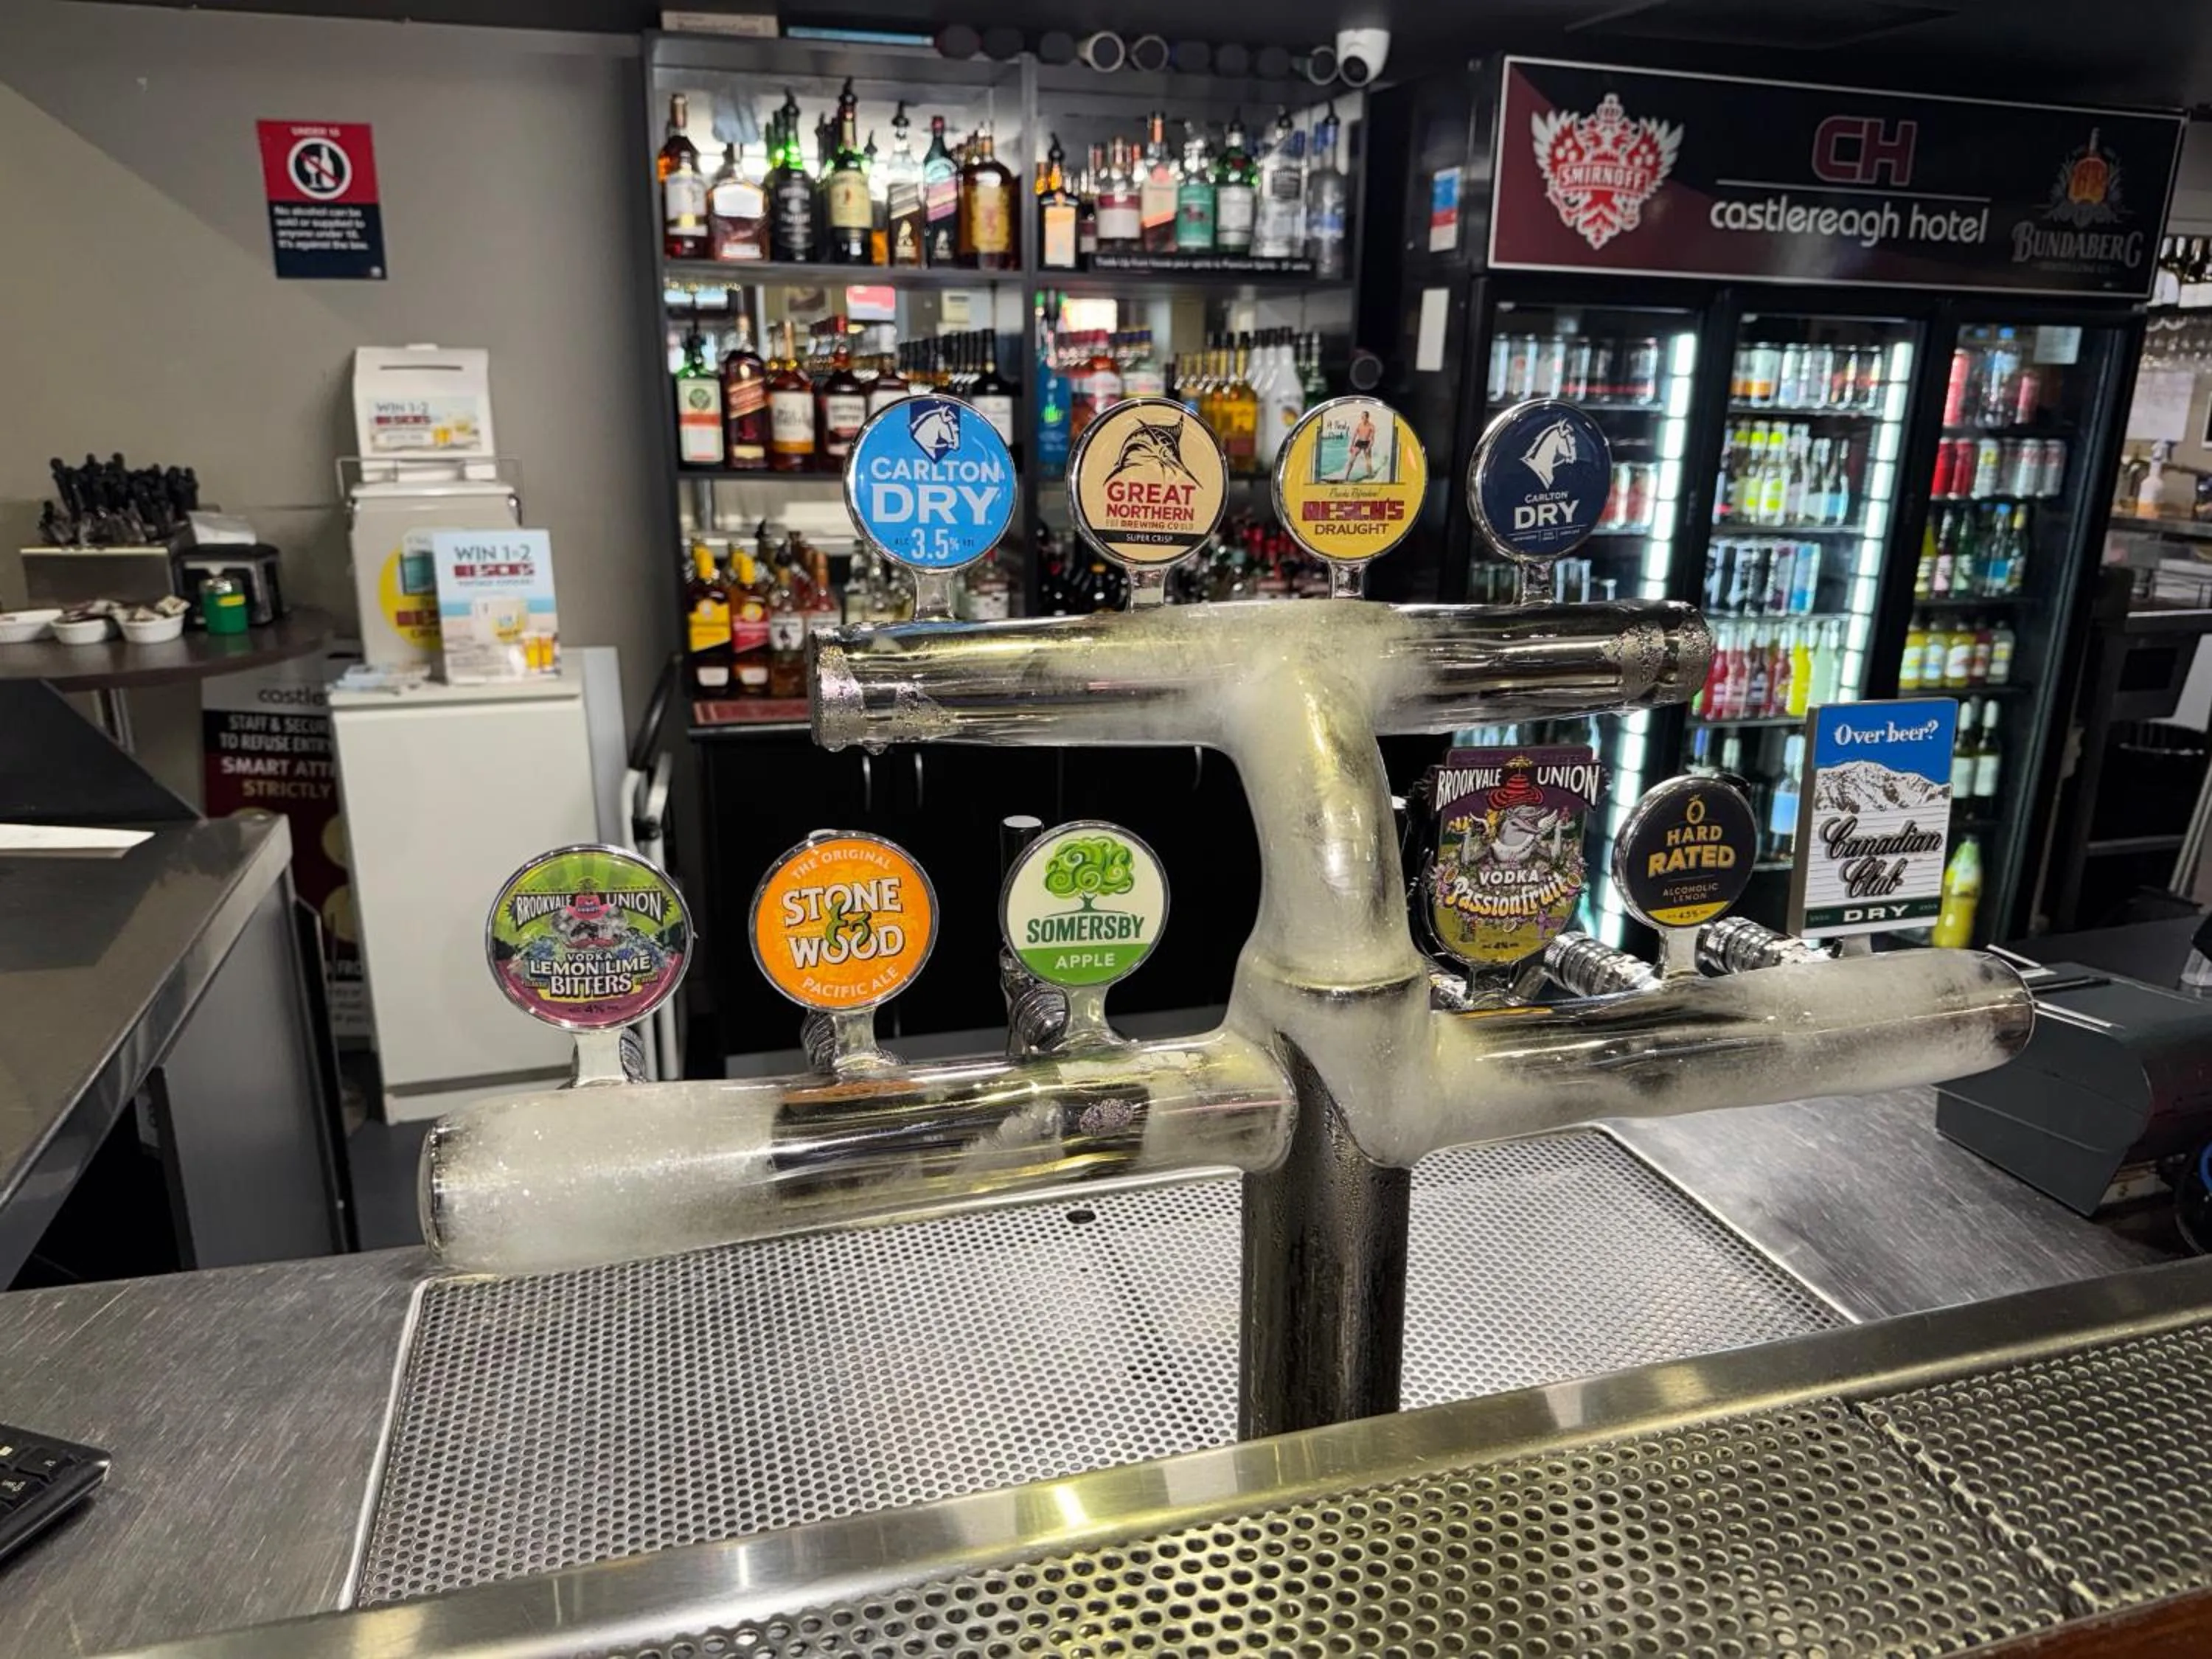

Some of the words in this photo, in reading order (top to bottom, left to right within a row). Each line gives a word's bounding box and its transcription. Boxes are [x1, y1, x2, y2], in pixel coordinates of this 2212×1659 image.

[1812, 115, 1917, 187] CH
[1559, 165, 1644, 192] SMIRNOFF
[1710, 194, 1900, 248] castlereagh
[1908, 204, 1989, 245] hotel
[871, 456, 1000, 483] CARLTON
[870, 483, 1000, 526] DRY
[1107, 481, 1196, 506] GREAT
[1524, 491, 1569, 504] CARLTON
[1106, 504, 1194, 521] NORTHERN
[1514, 500, 1581, 529] DRY
[1120, 520, 1165, 529] BREWING
[1315, 523, 1389, 535] DRAUGHT
[1126, 533, 1150, 542] SUPER
[1151, 535, 1174, 543] CRISP
[454, 545, 496, 561] WIN
[259, 686, 330, 706] castle
[229, 715, 267, 731] STAFF
[269, 717, 282, 732] &
[1834, 724, 1885, 745] Over
[1886, 720, 1939, 742] beer?
[219, 733, 239, 749] TO
[240, 734, 290, 751] REFUSE
[222, 757, 291, 776] SMART
[294, 760, 332, 779] ATT
[243, 780, 331, 799] STRICTLY
[1436, 768, 1502, 811] BROOKVALE
[1537, 765, 1600, 806] UNION
[1667, 825, 1723, 846] HARD
[1819, 815, 1944, 859] Canadian
[793, 858, 819, 879] THE
[821, 849, 891, 870] ORIGINAL
[1648, 844, 1736, 879] RATED
[1479, 869, 1540, 885] VODKA
[1840, 856, 1908, 898] Club
[782, 877, 902, 926] STONE
[1446, 872, 1568, 916] Passionfruit
[1663, 883, 1719, 897] ALCOHOLIC
[1673, 892, 1707, 904] LEMON
[517, 894, 572, 925] BROOKVALE
[606, 892, 662, 922] UNION
[1844, 904, 1910, 922] DRY
[826, 901, 872, 950] &
[1026, 914, 1144, 944] SOMERSBY
[566, 952, 613, 961] VODKA
[789, 925, 905, 968] WOOD
[530, 959, 599, 975] LEMON
[605, 954, 651, 971] LIME
[1054, 953, 1116, 970] APPLE
[551, 973, 633, 995] BITTERS
[802, 976, 867, 998] PACIFIC
[872, 967, 899, 991] ALE
